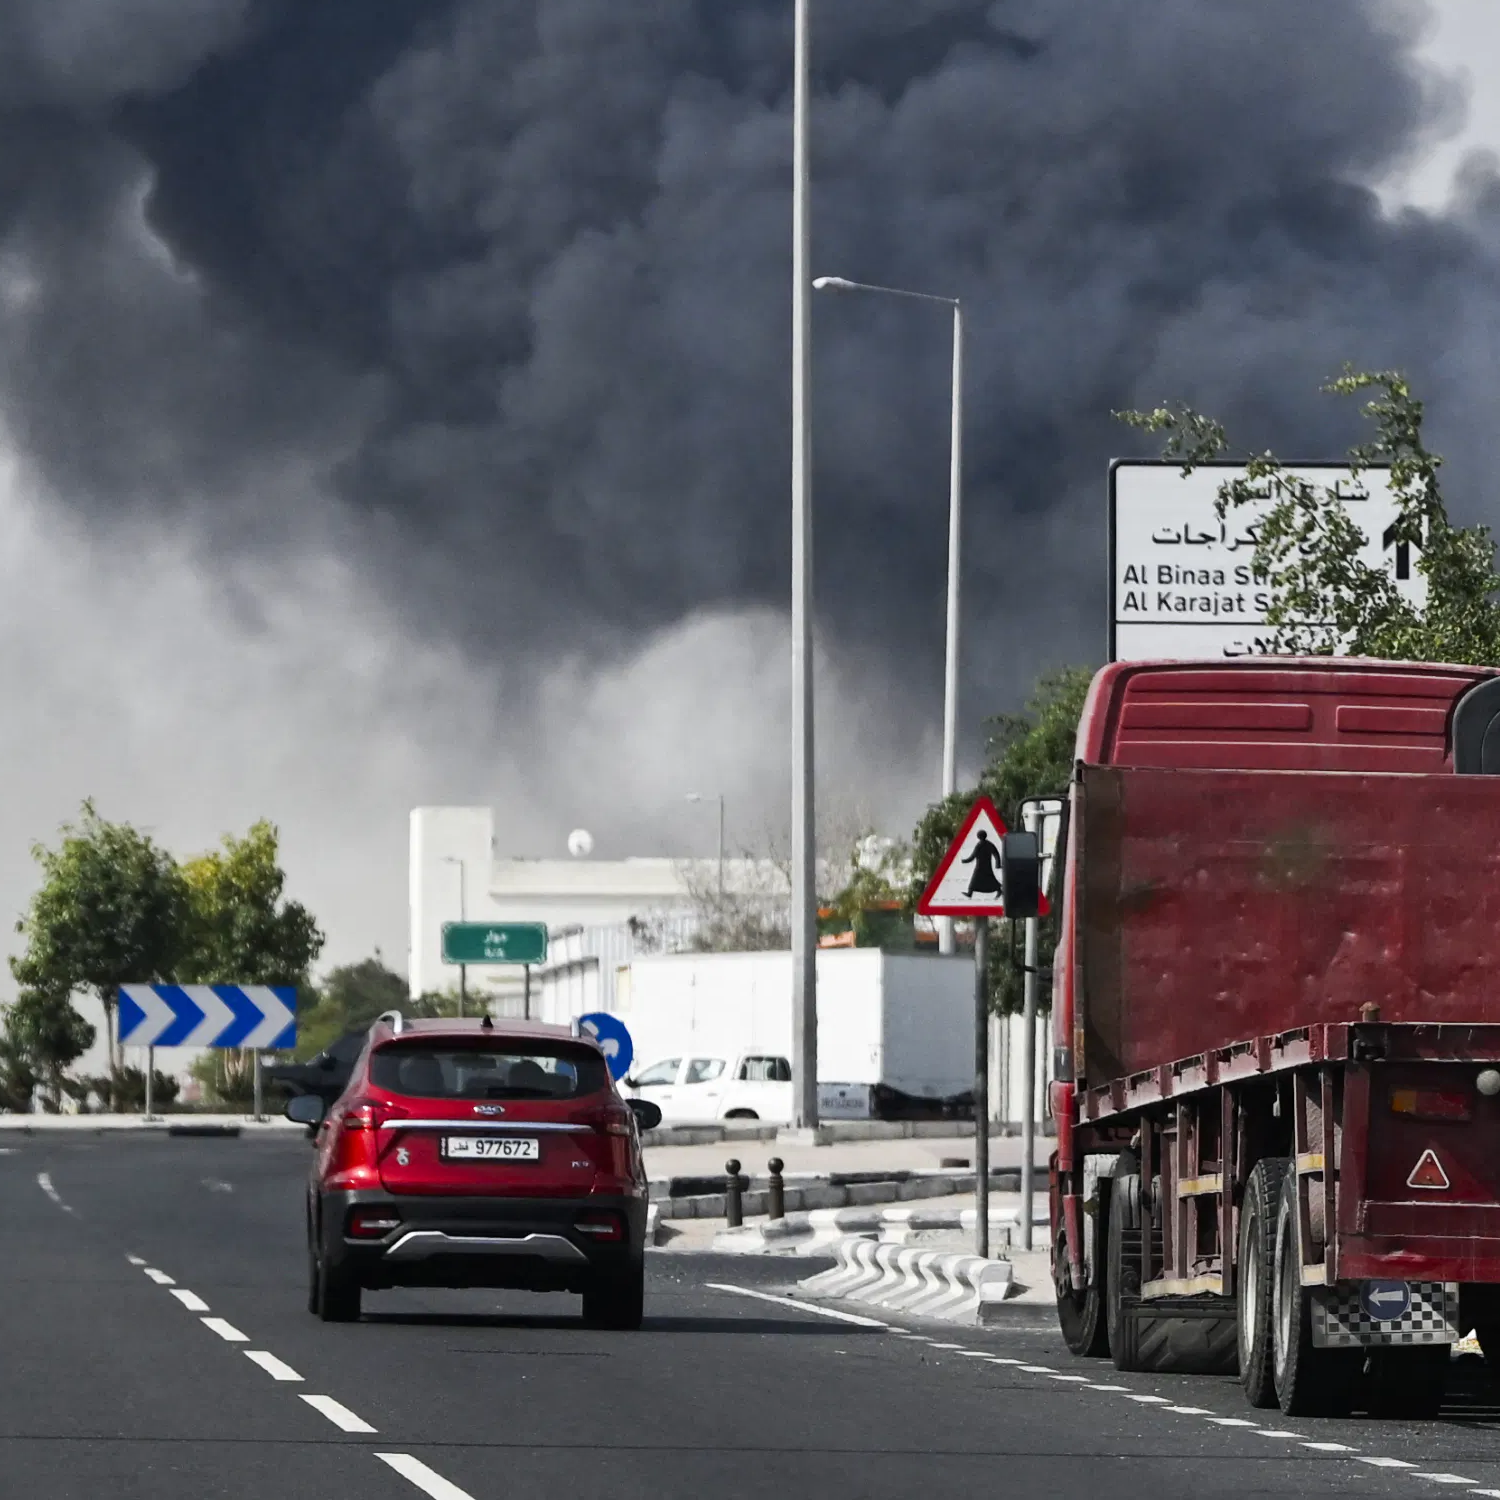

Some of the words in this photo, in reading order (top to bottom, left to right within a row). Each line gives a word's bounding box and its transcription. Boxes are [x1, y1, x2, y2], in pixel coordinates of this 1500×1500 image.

[1122, 564, 1148, 584] Al
[1157, 564, 1225, 585] Binaa
[1122, 591, 1148, 611] Al
[1157, 591, 1245, 616] Karajat
[475, 1139, 531, 1156] 977672
